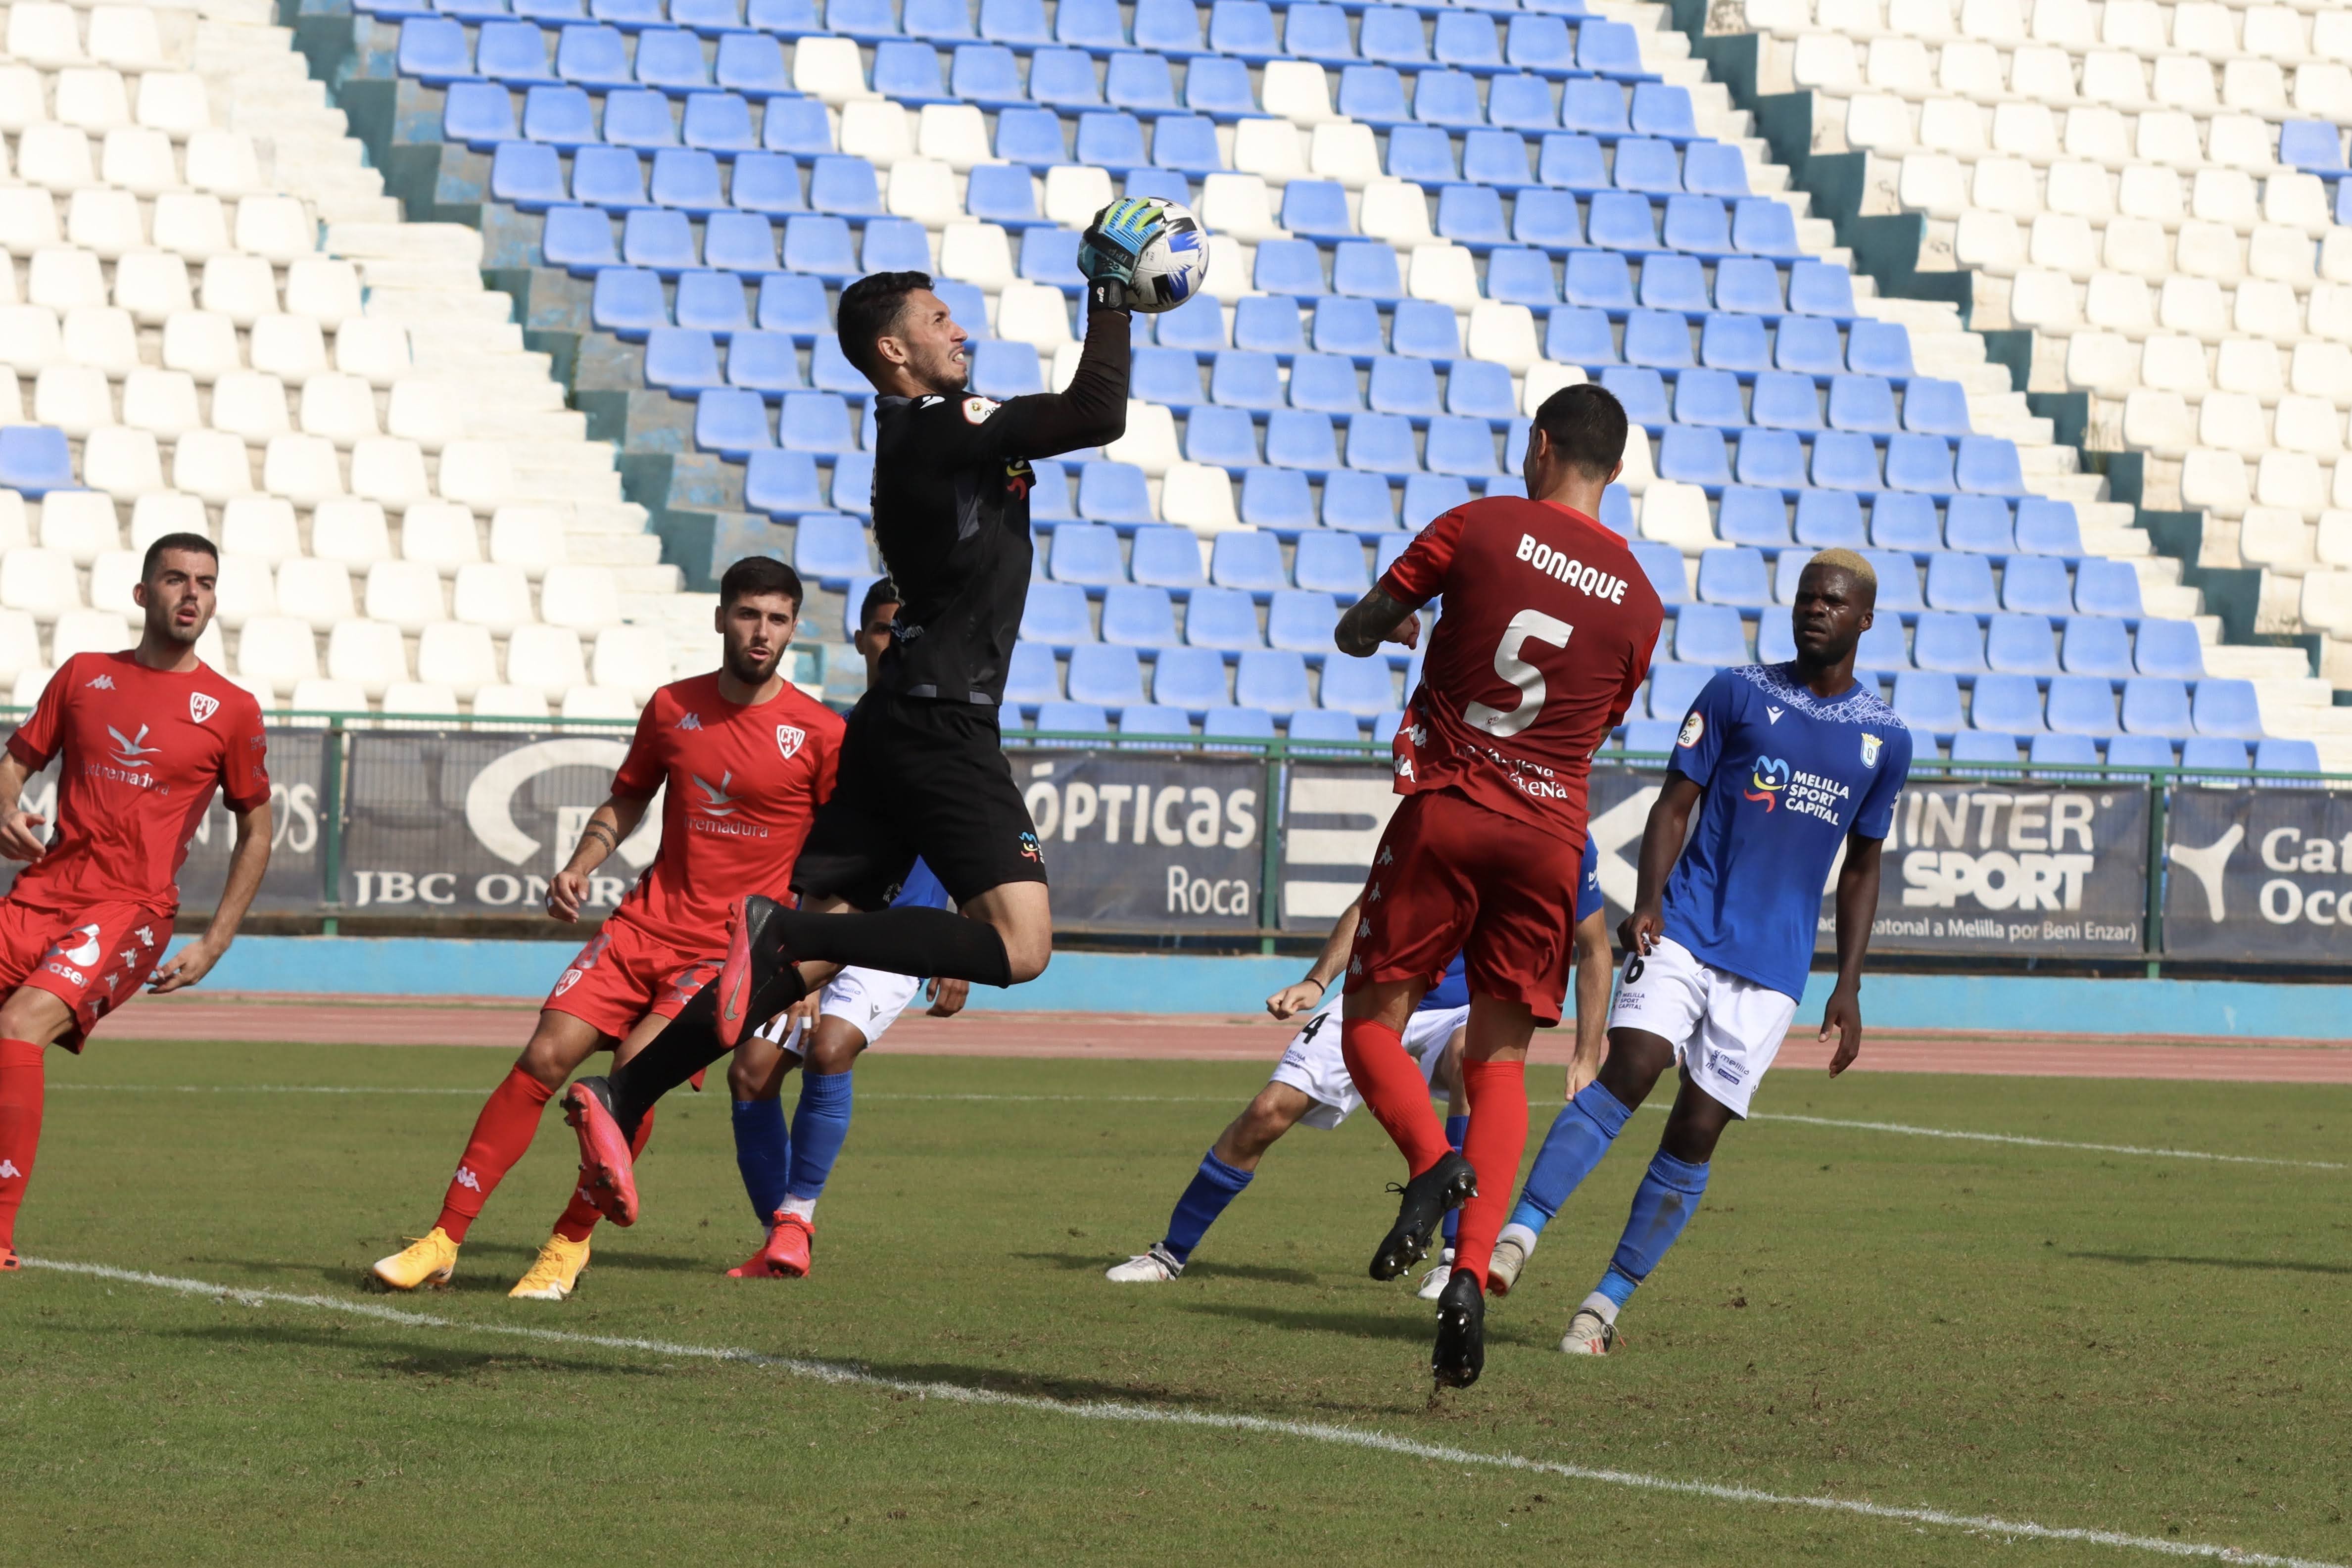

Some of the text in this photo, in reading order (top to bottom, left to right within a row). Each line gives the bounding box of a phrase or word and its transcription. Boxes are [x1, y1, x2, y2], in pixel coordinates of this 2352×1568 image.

[1516, 533, 1629, 605] BONAQUE
[1463, 609, 1574, 737] 5
[1789, 784, 1836, 808] SPORT
[1792, 770, 1850, 800] MELILLA
[1785, 797, 1839, 826] CAPITAL
[1905, 792, 2095, 852] INTER
[353, 871, 456, 907] JBC
[1167, 865, 1249, 916] Roca
[1902, 850, 2095, 911] SPORT
[1933, 922, 1944, 936] a
[1948, 918, 2005, 938] Melilla
[2009, 924, 2039, 943] por
[2085, 921, 2137, 944] Enzar)
[1302, 1012, 1331, 1045] 4
[1720, 1054, 1750, 1075] melilla
